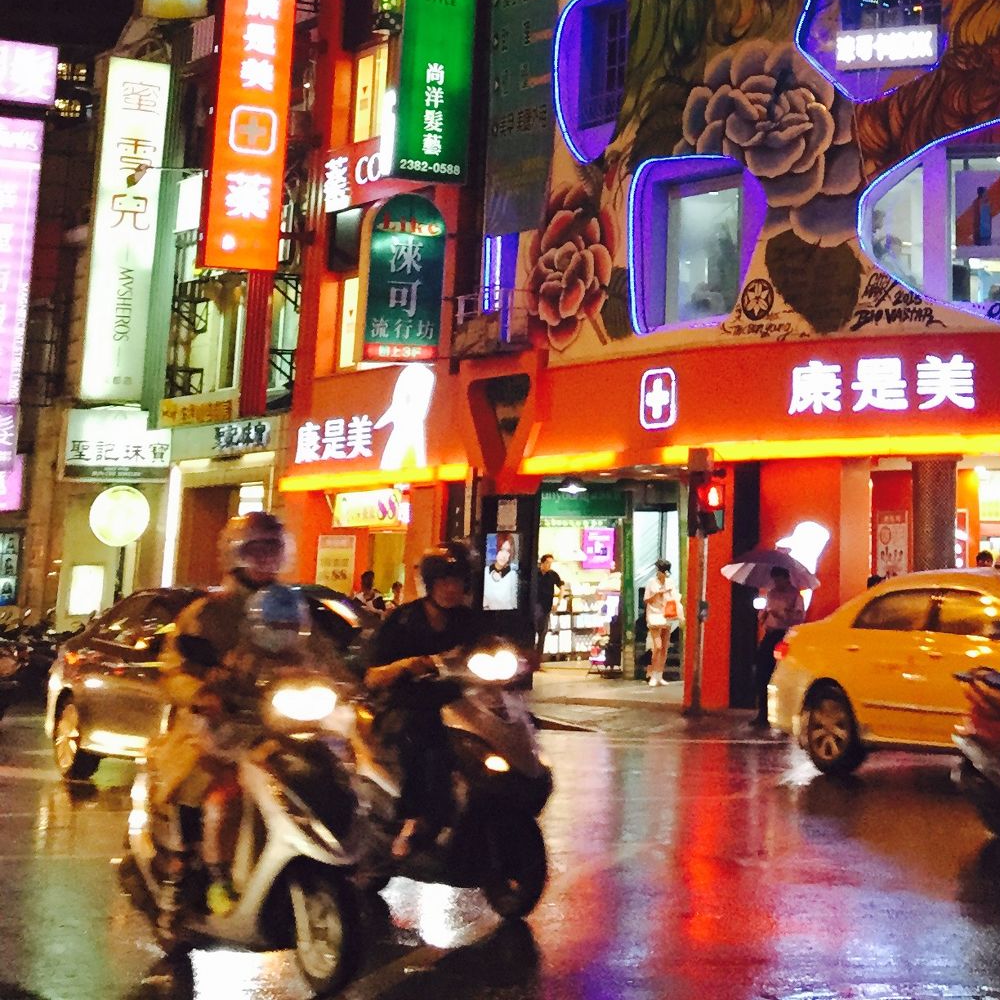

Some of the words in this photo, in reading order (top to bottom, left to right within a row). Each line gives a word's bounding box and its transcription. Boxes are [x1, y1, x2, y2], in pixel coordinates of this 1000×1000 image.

[421, 62, 445, 156] 尚洋髮藝
[400, 158, 460, 176] 2382-0588
[371, 316, 435, 339] 流行坊
[787, 354, 976, 414] 康是美
[66, 439, 170, 463] 聖記珠寶
[294, 414, 373, 464] 康是美
